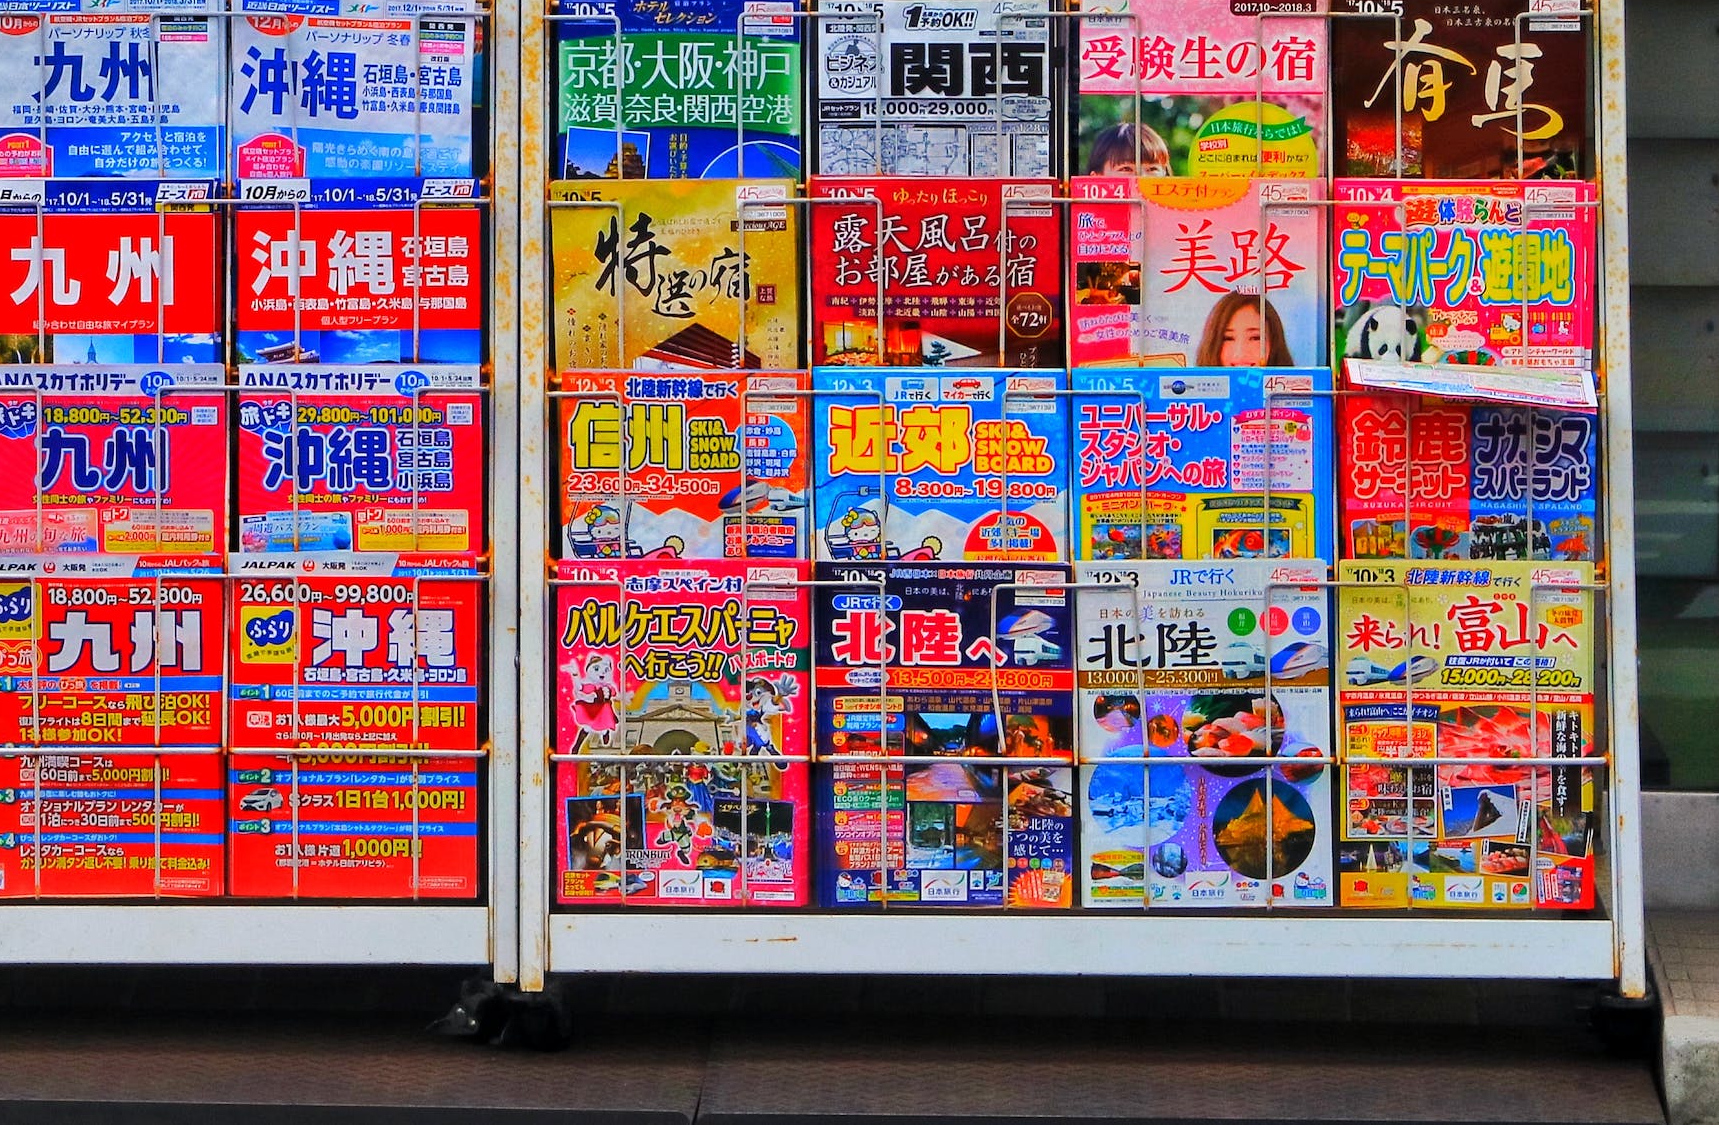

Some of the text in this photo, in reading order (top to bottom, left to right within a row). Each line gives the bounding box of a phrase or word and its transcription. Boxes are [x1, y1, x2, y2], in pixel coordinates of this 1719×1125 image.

[32, 41, 158, 103] 九州
[239, 45, 359, 119] 沖縄
[566, 42, 792, 89] 京都・大阪・神戸
[890, 42, 1046, 97] 関西
[1081, 35, 1316, 82] 受験生の宿
[564, 93, 794, 126] 滋賀・奈良・関西空港
[1150, 182, 1236, 199] エステ付プラン
[10, 235, 174, 307] 九州
[250, 230, 396, 297] 沖縄
[1160, 222, 1307, 295] 美路
[626, 378, 737, 399] 北陸新幹線で行く
[40, 426, 169, 493] 九州
[262, 426, 389, 491] 沖縄
[570, 402, 686, 472] 信州
[829, 405, 971, 476] 近郊
[1351, 411, 1467, 465] 鈴鹿
[1169, 567, 1235, 585] JRで行く
[50, 610, 200, 672] 九州
[832, 610, 959, 663] 北陸
[1087, 621, 1219, 669] 北陸
